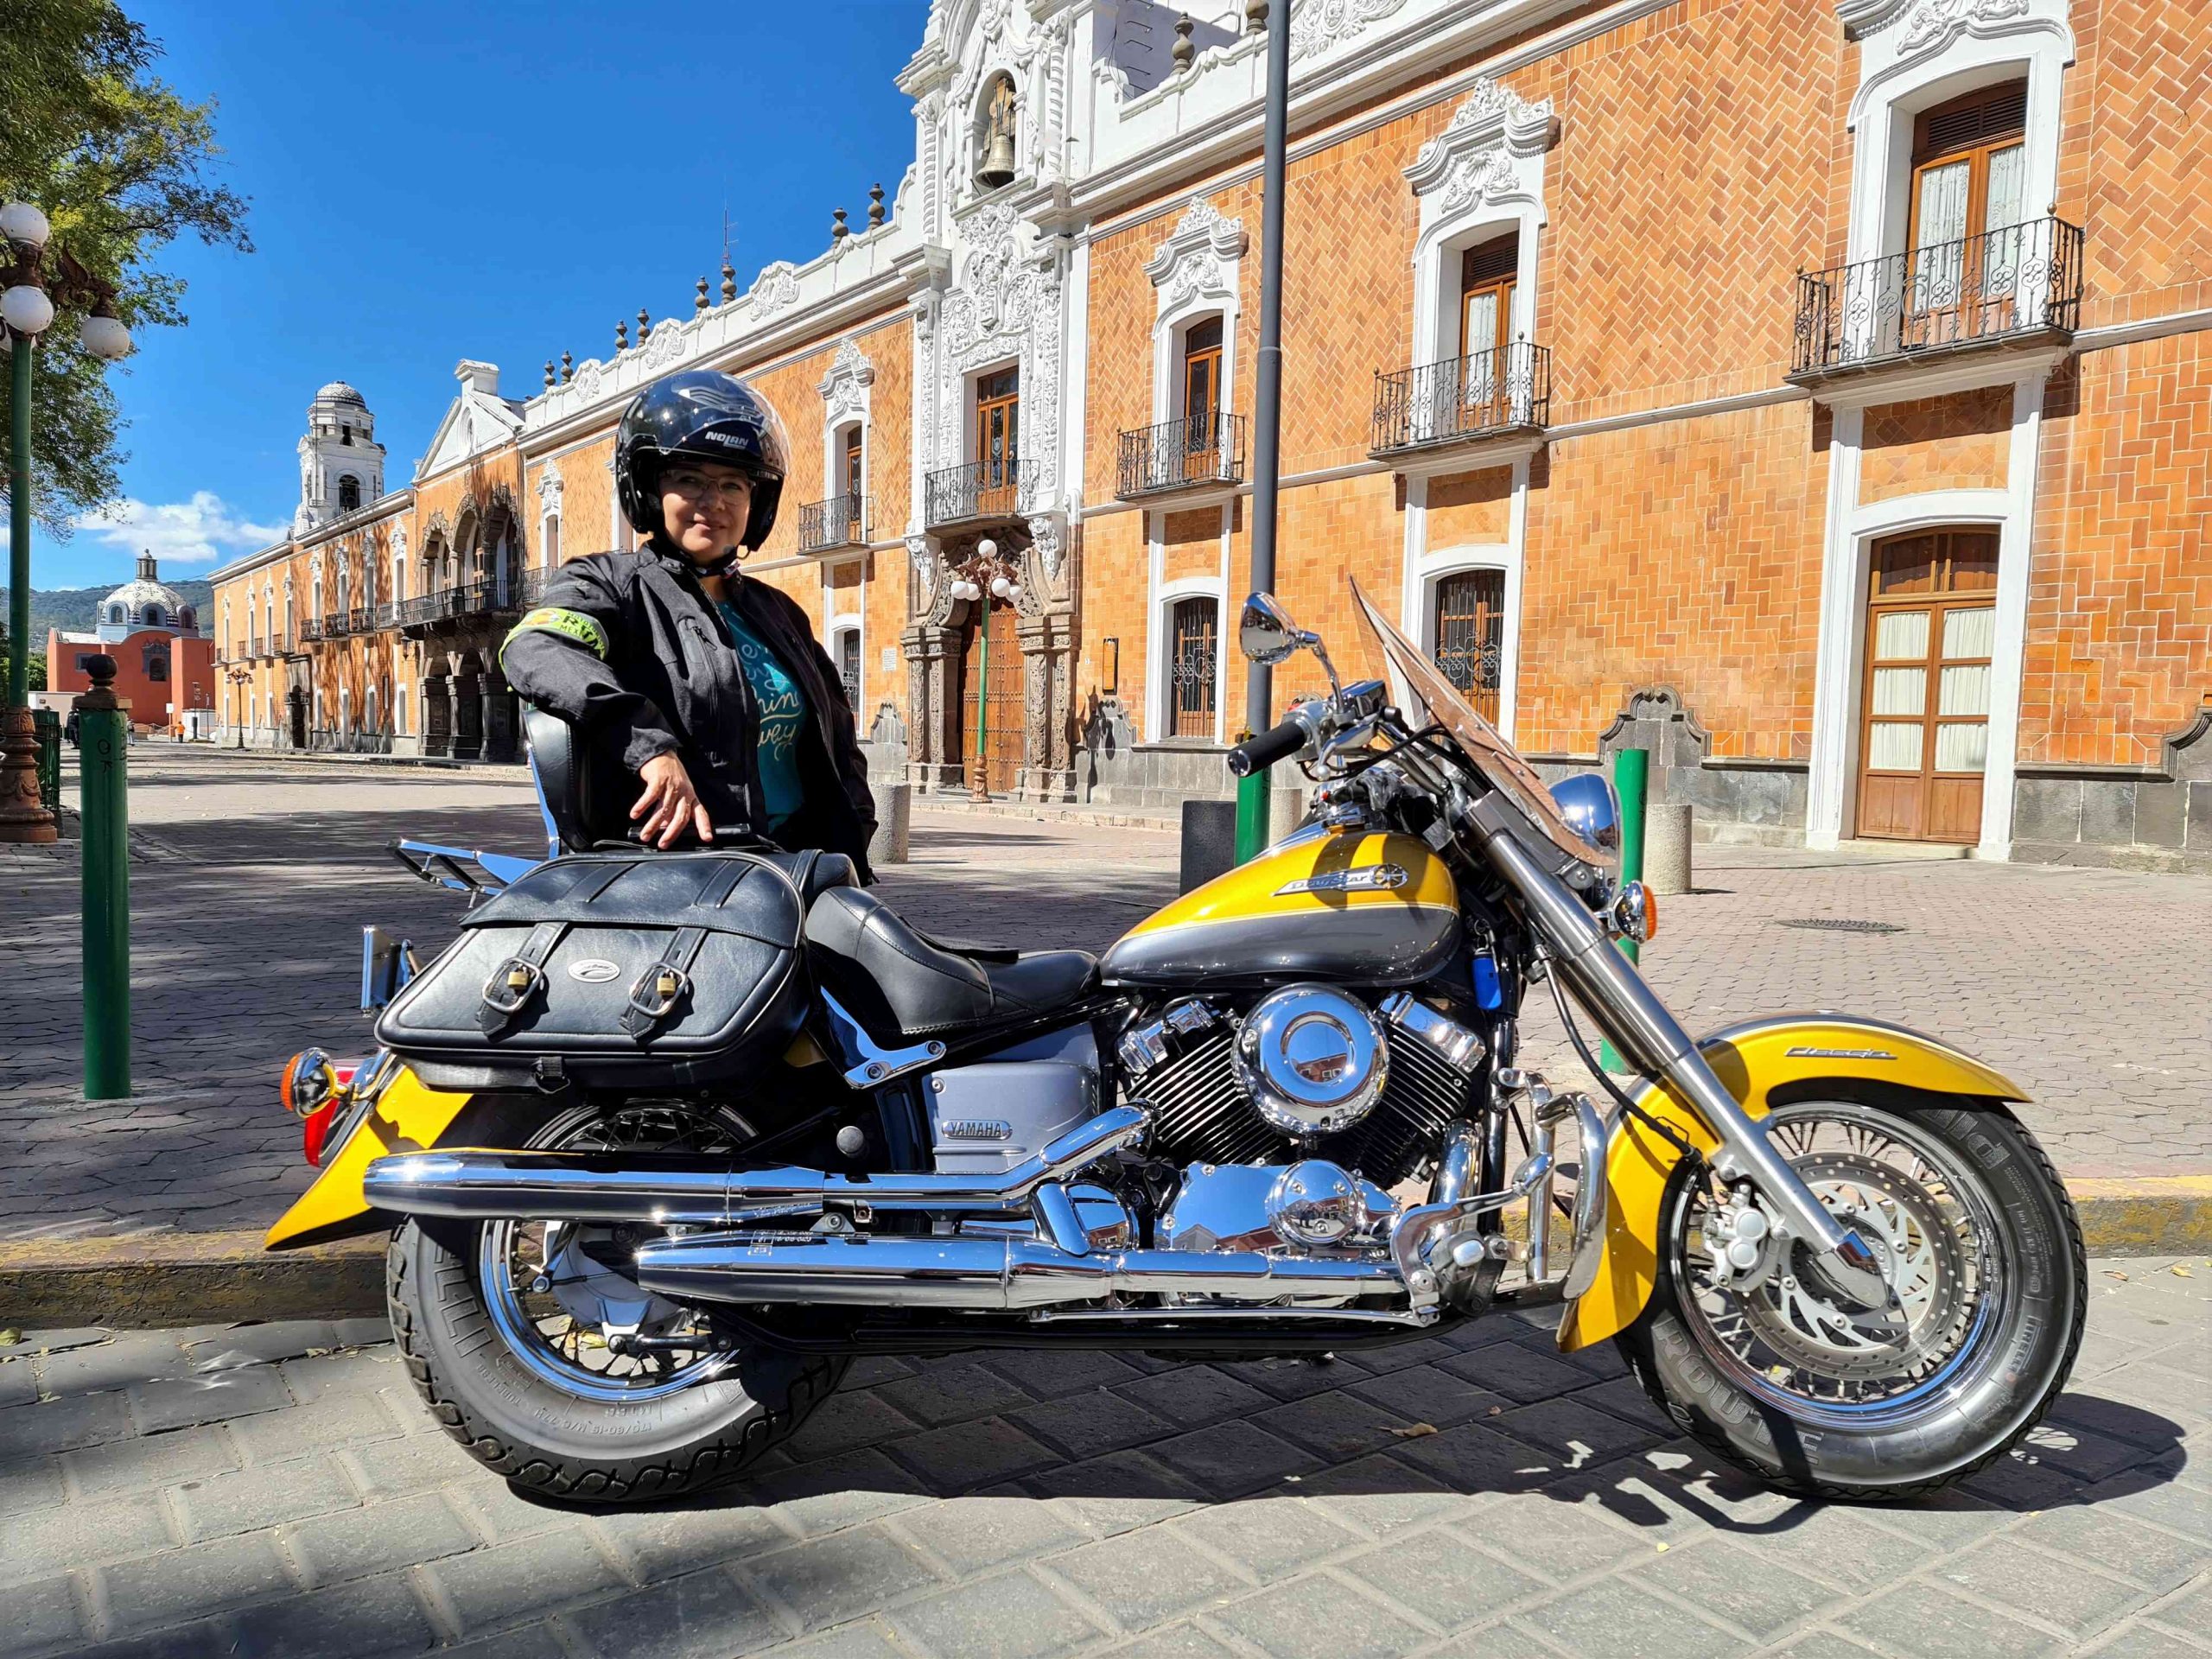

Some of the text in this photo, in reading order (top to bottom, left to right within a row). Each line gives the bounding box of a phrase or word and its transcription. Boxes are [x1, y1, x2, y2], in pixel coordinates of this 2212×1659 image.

[705, 431, 749, 449] NOLAN
[1783, 1046, 1898, 1060] Classic
[950, 1122, 1002, 1136] YAMAHA
